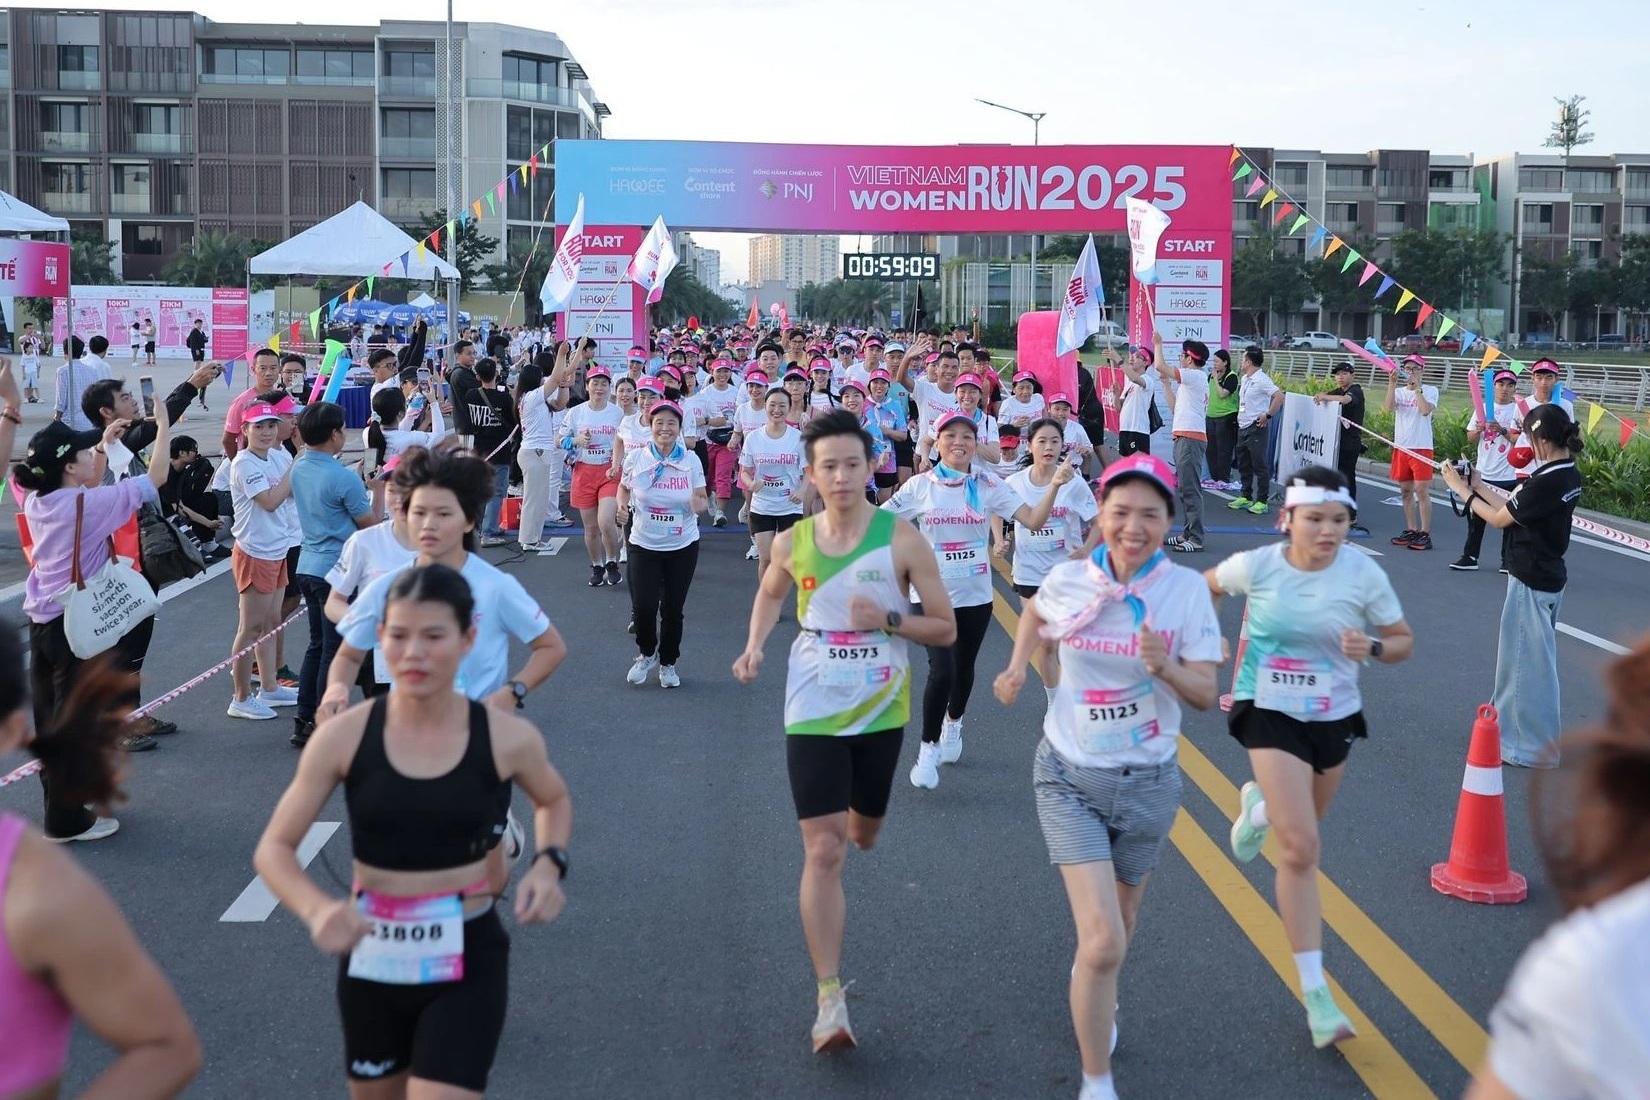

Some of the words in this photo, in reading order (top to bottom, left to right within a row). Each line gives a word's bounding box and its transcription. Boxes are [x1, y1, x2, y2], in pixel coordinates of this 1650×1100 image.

[847, 165, 966, 186] VIETNAM
[684, 177, 736, 192] Content
[849, 190, 966, 210] WOMEN
[967, 165, 1037, 211] RUN
[1039, 164, 1187, 212] 2025
[783, 182, 813, 203] PNJ
[582, 235, 624, 247] TART
[1164, 239, 1215, 252] START
[848, 256, 935, 276] 00:59:09
[595, 323, 614, 335] PNJ
[1184, 327, 1203, 338] PNJ
[670, 477, 689, 490] RUN
[925, 517, 964, 525] WOMEN
[945, 551, 976, 560] 51125
[93, 617, 120, 637] twice
[123, 597, 146, 618] year.
[828, 647, 879, 660] 50573
[1271, 672, 1317, 686] 51178
[1089, 702, 1138, 721] 51123
[371, 924, 443, 942] 3808
